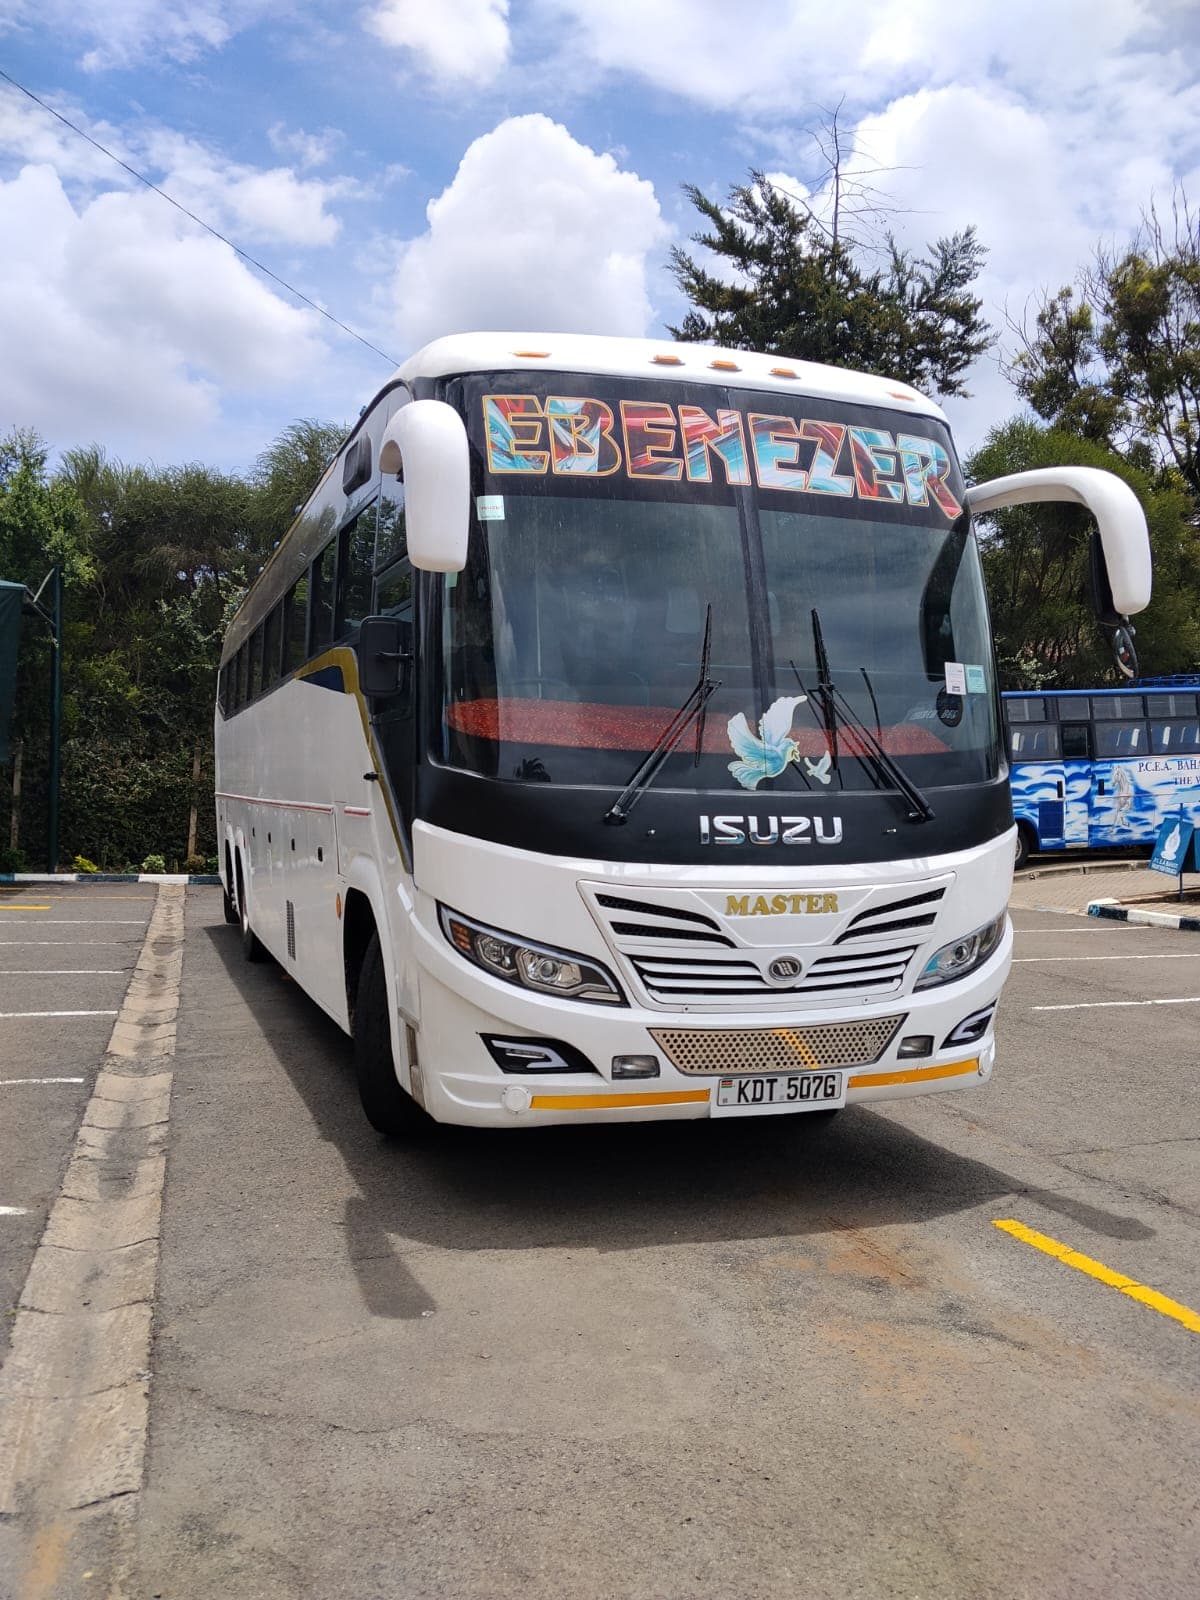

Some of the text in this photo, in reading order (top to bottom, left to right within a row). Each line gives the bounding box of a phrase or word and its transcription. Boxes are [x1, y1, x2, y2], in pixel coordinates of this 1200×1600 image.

[482, 394, 963, 520] EBENEZER
[1173, 776, 1192, 785] THE
[700, 815, 843, 844] ISUZU
[725, 893, 839, 917] MASTER
[737, 1074, 836, 1103] KDT 507G
